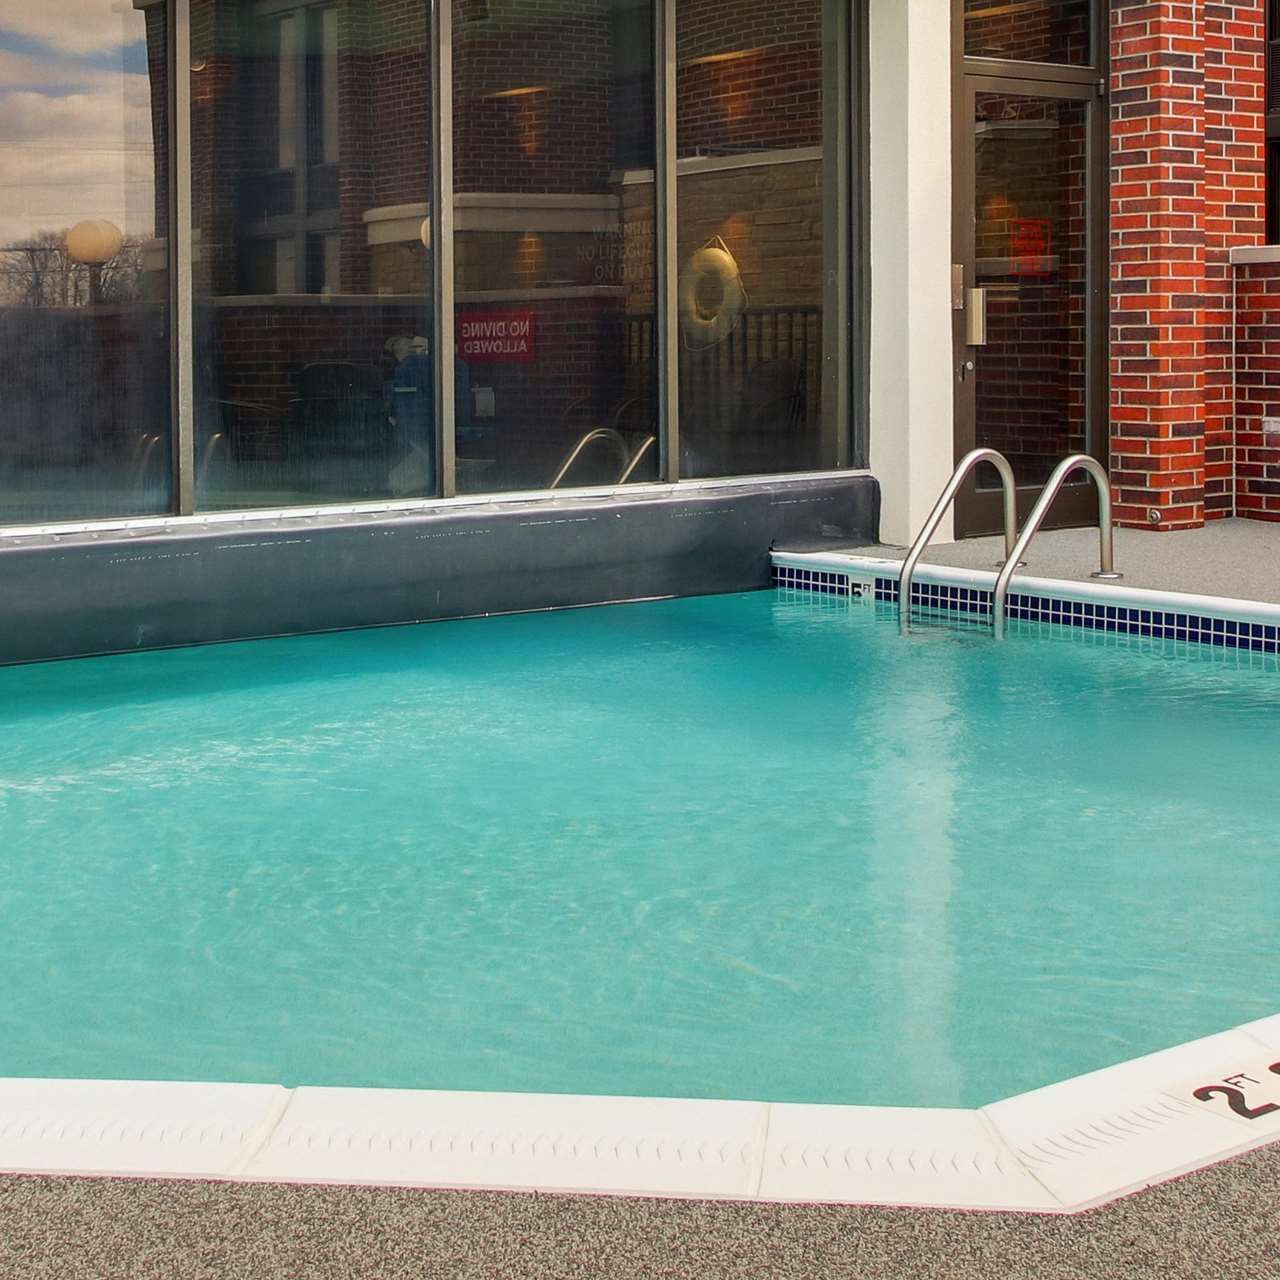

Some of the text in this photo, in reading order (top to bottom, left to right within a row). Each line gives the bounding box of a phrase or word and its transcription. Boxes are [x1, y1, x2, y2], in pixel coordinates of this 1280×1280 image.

[592, 222, 651, 240] WARNIN
[599, 242, 651, 261] LIFEGU
[594, 264, 614, 280] ON
[851, 583, 862, 597] 5
[1222, 1073, 1261, 1089] FT
